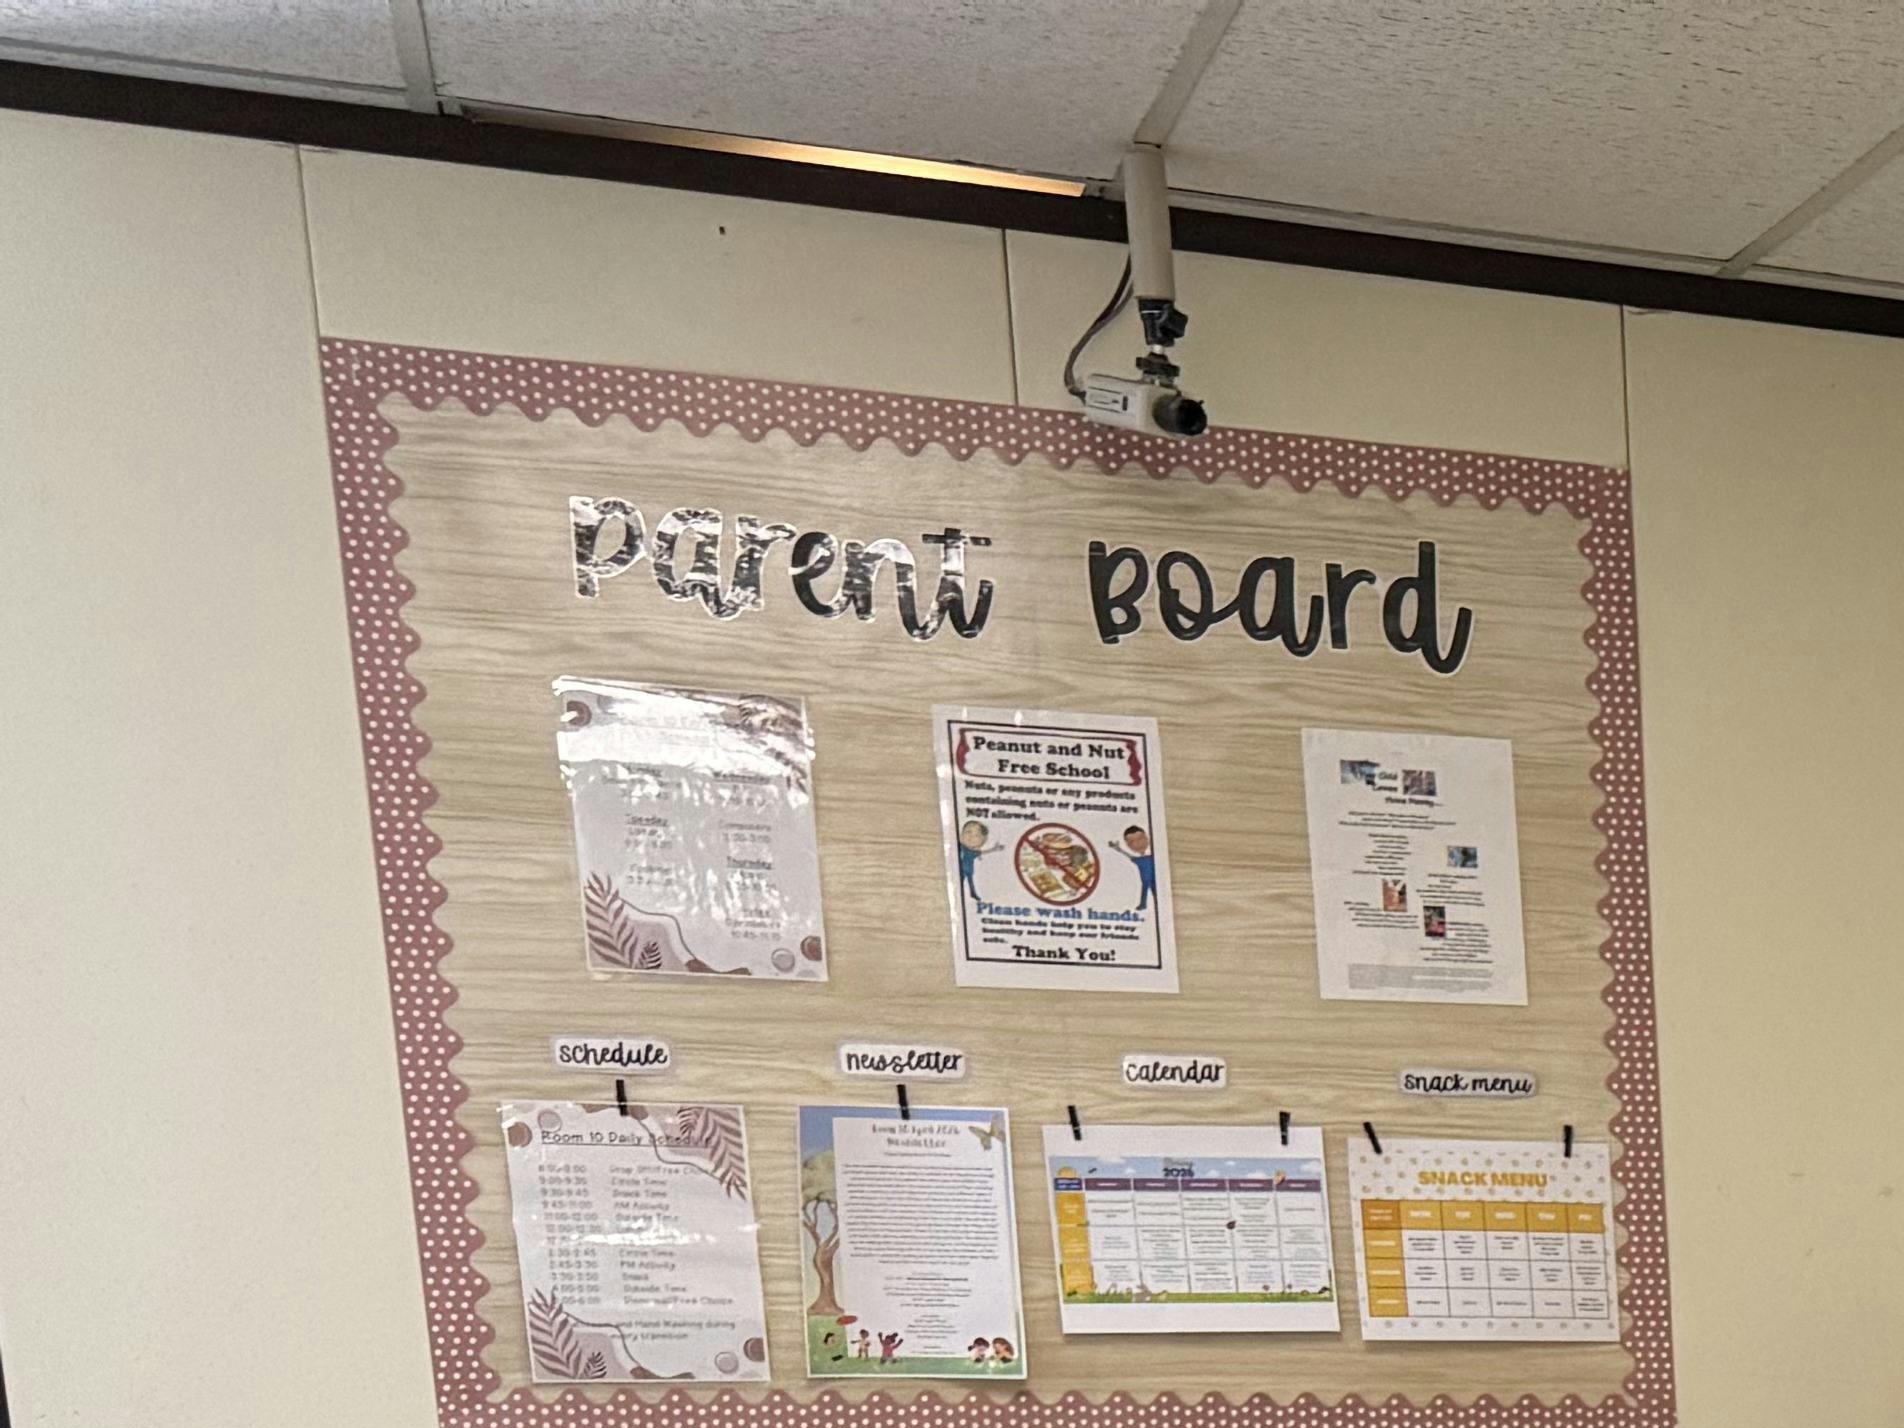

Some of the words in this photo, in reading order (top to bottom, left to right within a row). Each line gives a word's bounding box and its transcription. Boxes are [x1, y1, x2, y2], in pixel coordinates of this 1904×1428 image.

[972, 735, 1042, 755] Peanut
[1046, 741, 1083, 758] and
[1088, 743, 1126, 760] Nut
[997, 758, 1040, 775] Free
[1045, 761, 1110, 780] School
[965, 795, 1028, 809] containing
[1057, 801, 1071, 810] or
[1045, 786, 1059, 796] or
[1061, 787, 1082, 799] any
[1085, 788, 1137, 802] products
[966, 806, 989, 819] NOT
[991, 808, 1041, 822] allowed.
[976, 901, 1032, 918] Please
[1037, 905, 1083, 921] wash
[1087, 907, 1147, 923] hands.
[1012, 944, 1070, 960] Thank
[1075, 947, 1117, 962] You!
[559, 1041, 669, 1067] schedule
[846, 1049, 963, 1074] newsletter
[1125, 1059, 1225, 1084] calendar
[1404, 1073, 1469, 1093] snack
[1471, 1076, 1533, 1095] menu
[589, 1131, 605, 1145] 10
[1417, 1169, 1489, 1187] SNACK
[1491, 1172, 1549, 1189] MENU
